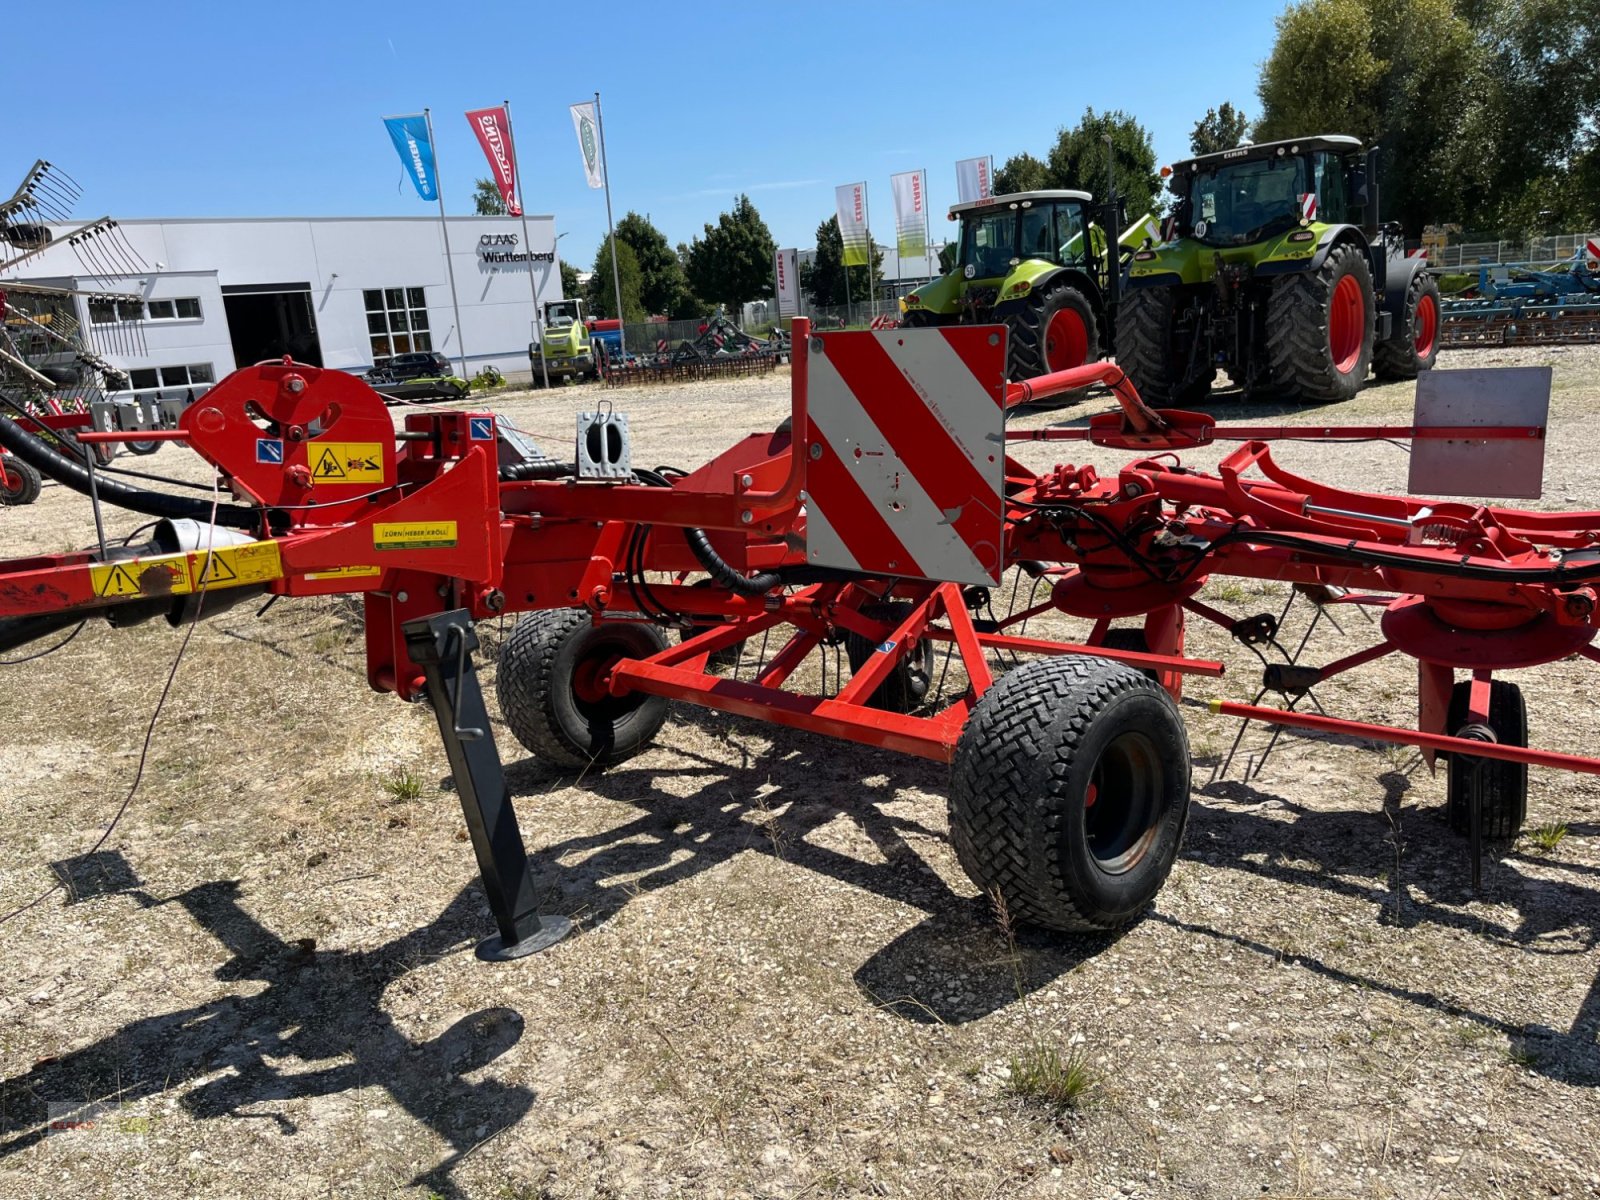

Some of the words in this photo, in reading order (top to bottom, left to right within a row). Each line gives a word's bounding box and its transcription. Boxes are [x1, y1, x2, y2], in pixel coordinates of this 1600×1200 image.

[1196, 224, 1205, 236] 40
[480, 233, 519, 246] CLAAS
[967, 265, 974, 276] 50
